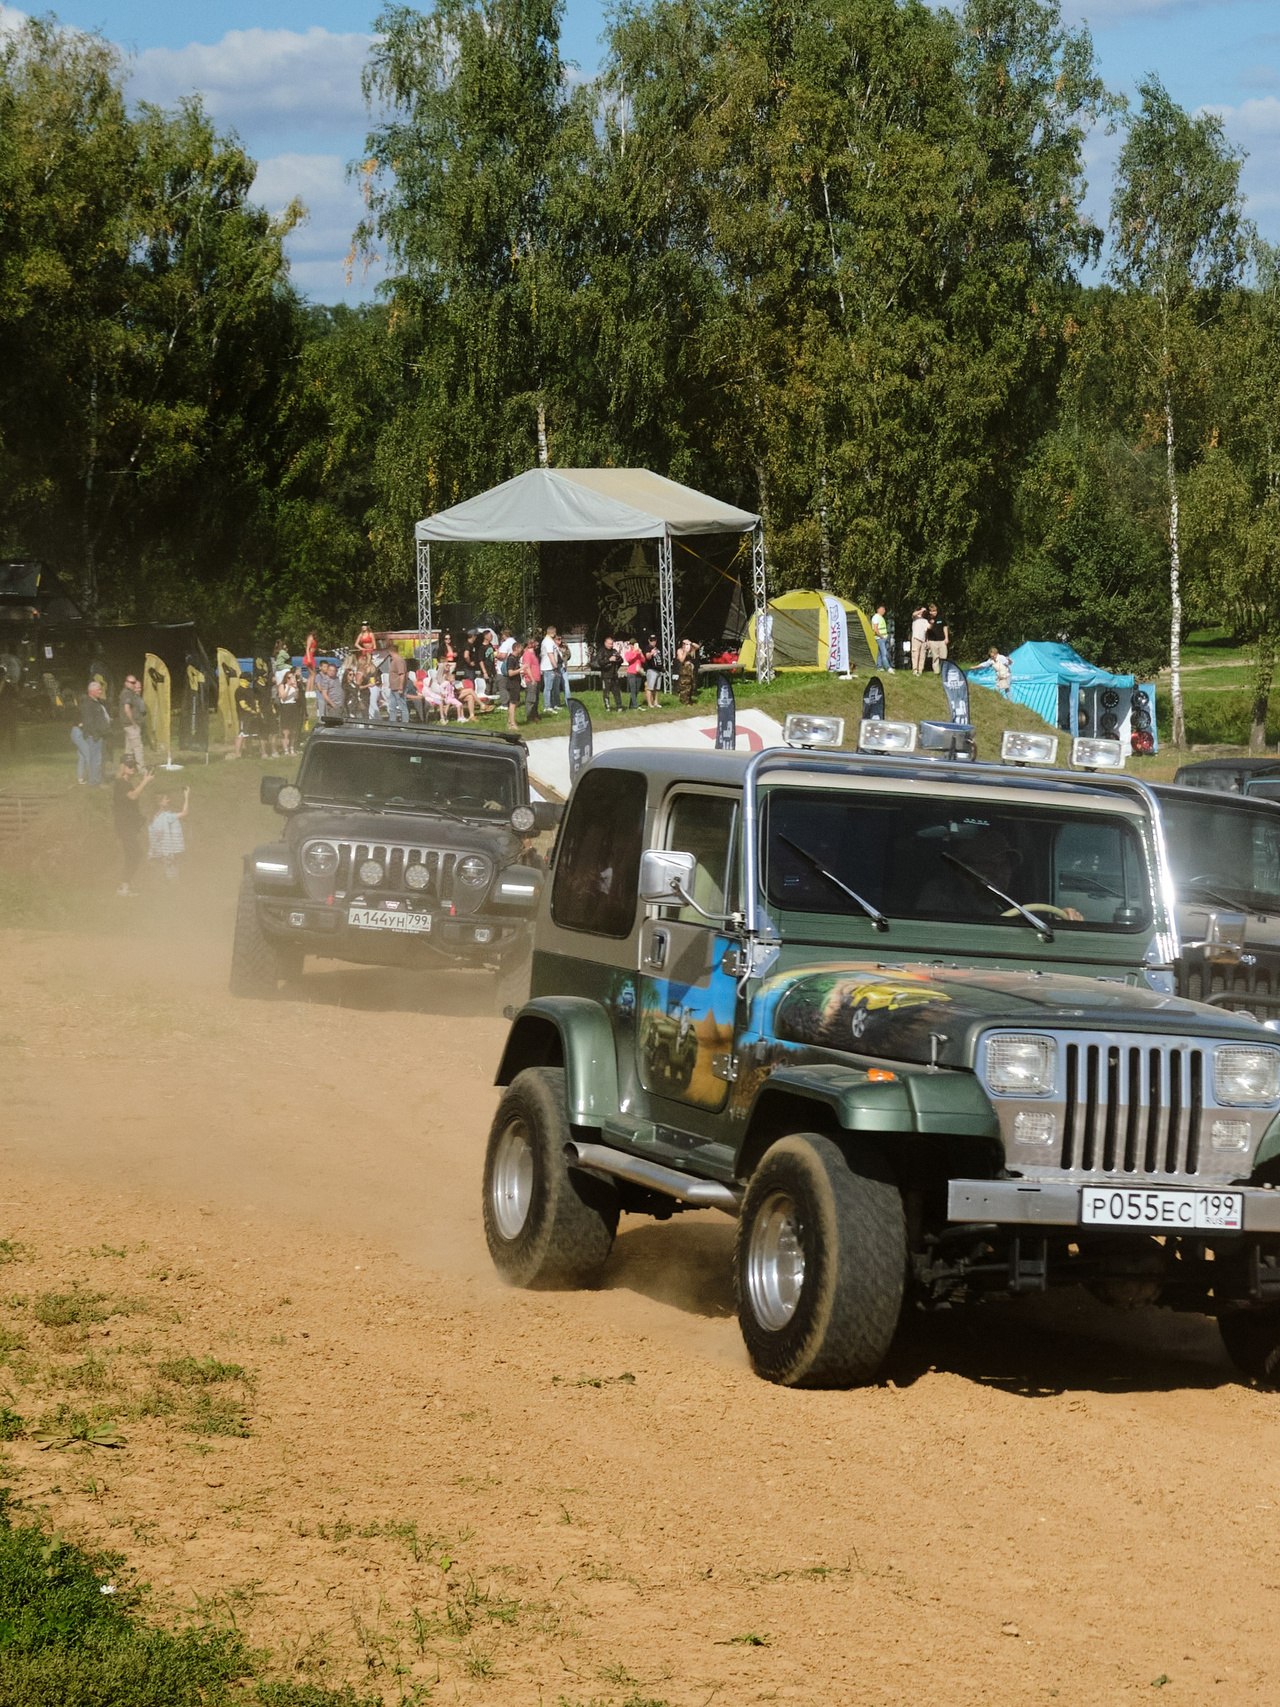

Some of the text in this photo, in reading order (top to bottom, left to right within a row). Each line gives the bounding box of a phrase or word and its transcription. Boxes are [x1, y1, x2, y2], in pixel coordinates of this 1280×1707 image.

[829, 624, 838, 671] TANK
[352, 911, 428, 927] А144УН 799
[1093, 1192, 1235, 1222] Р055ЕС 199
[1205, 1217, 1225, 1226] RUS
